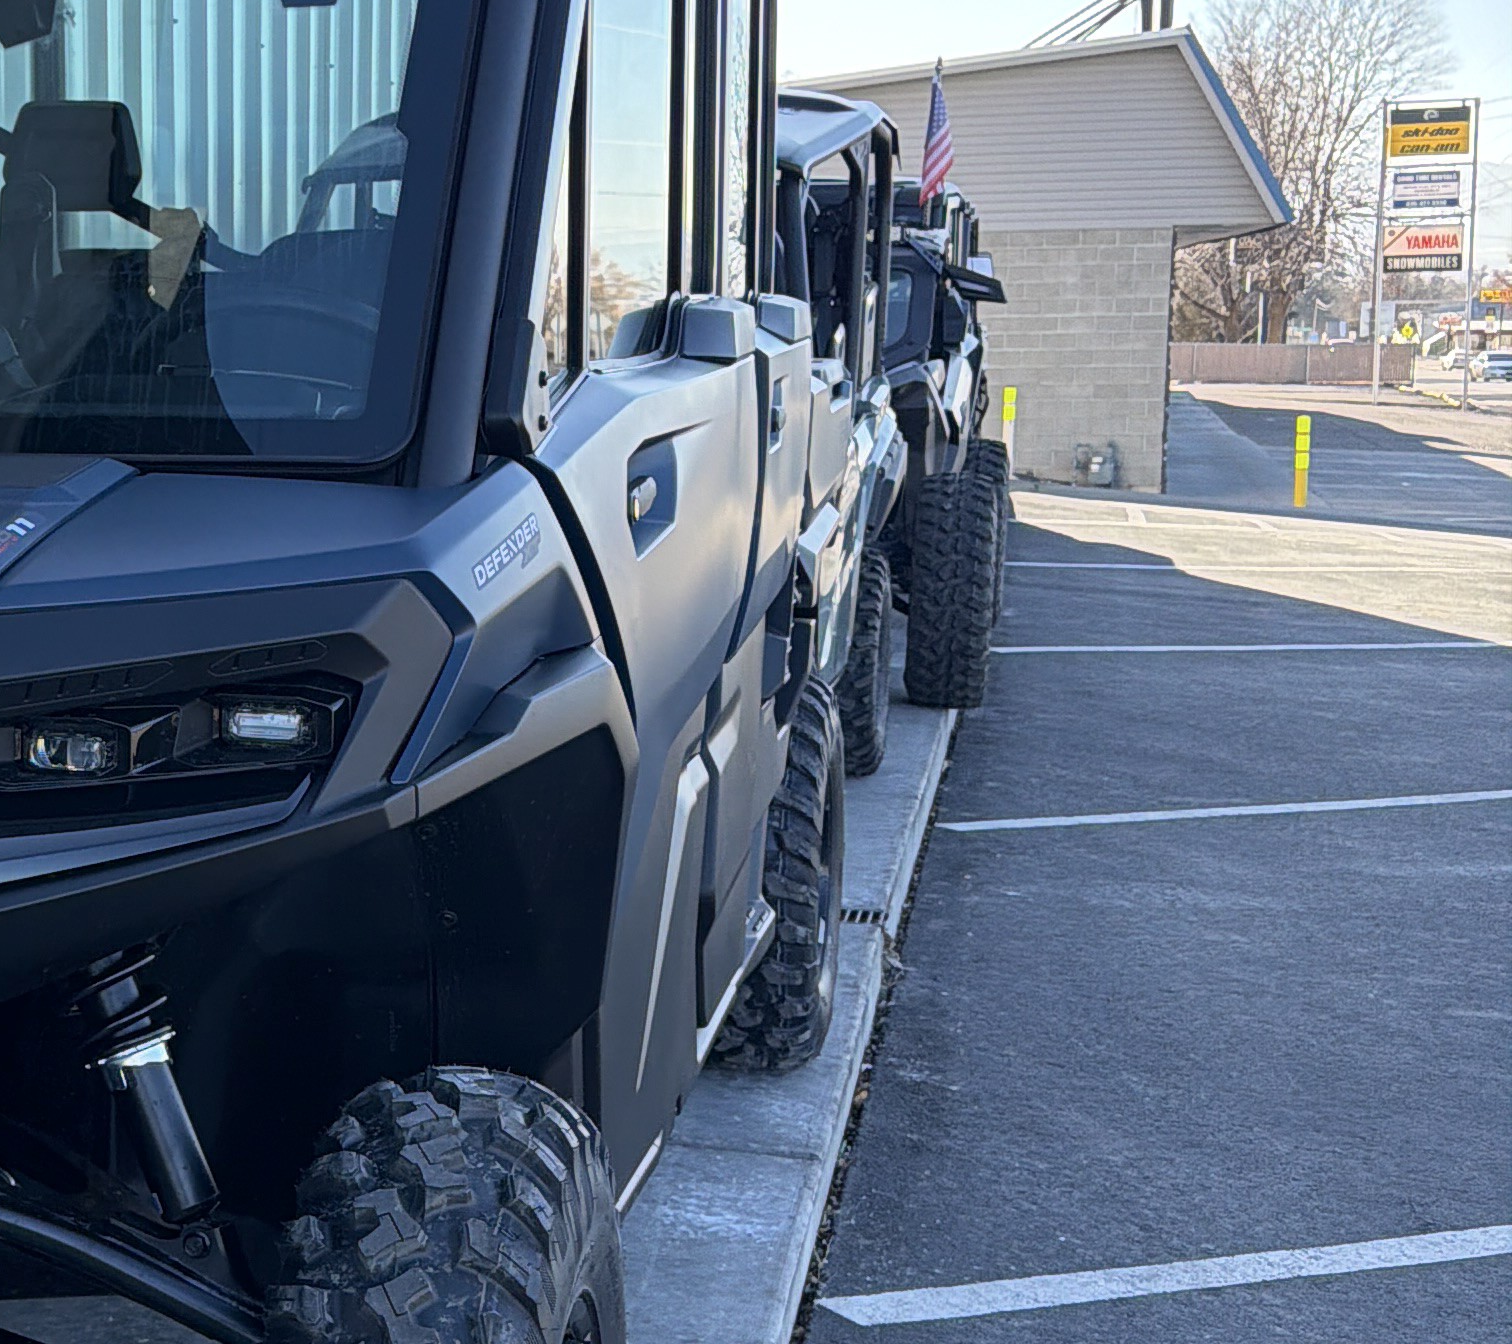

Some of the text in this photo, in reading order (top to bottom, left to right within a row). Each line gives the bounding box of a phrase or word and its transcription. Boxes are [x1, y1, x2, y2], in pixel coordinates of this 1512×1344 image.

[1405, 233, 1459, 250] YAMAHA
[1386, 255, 1459, 270] SNOWMOBILES
[473, 514, 539, 588] DEFENDER
